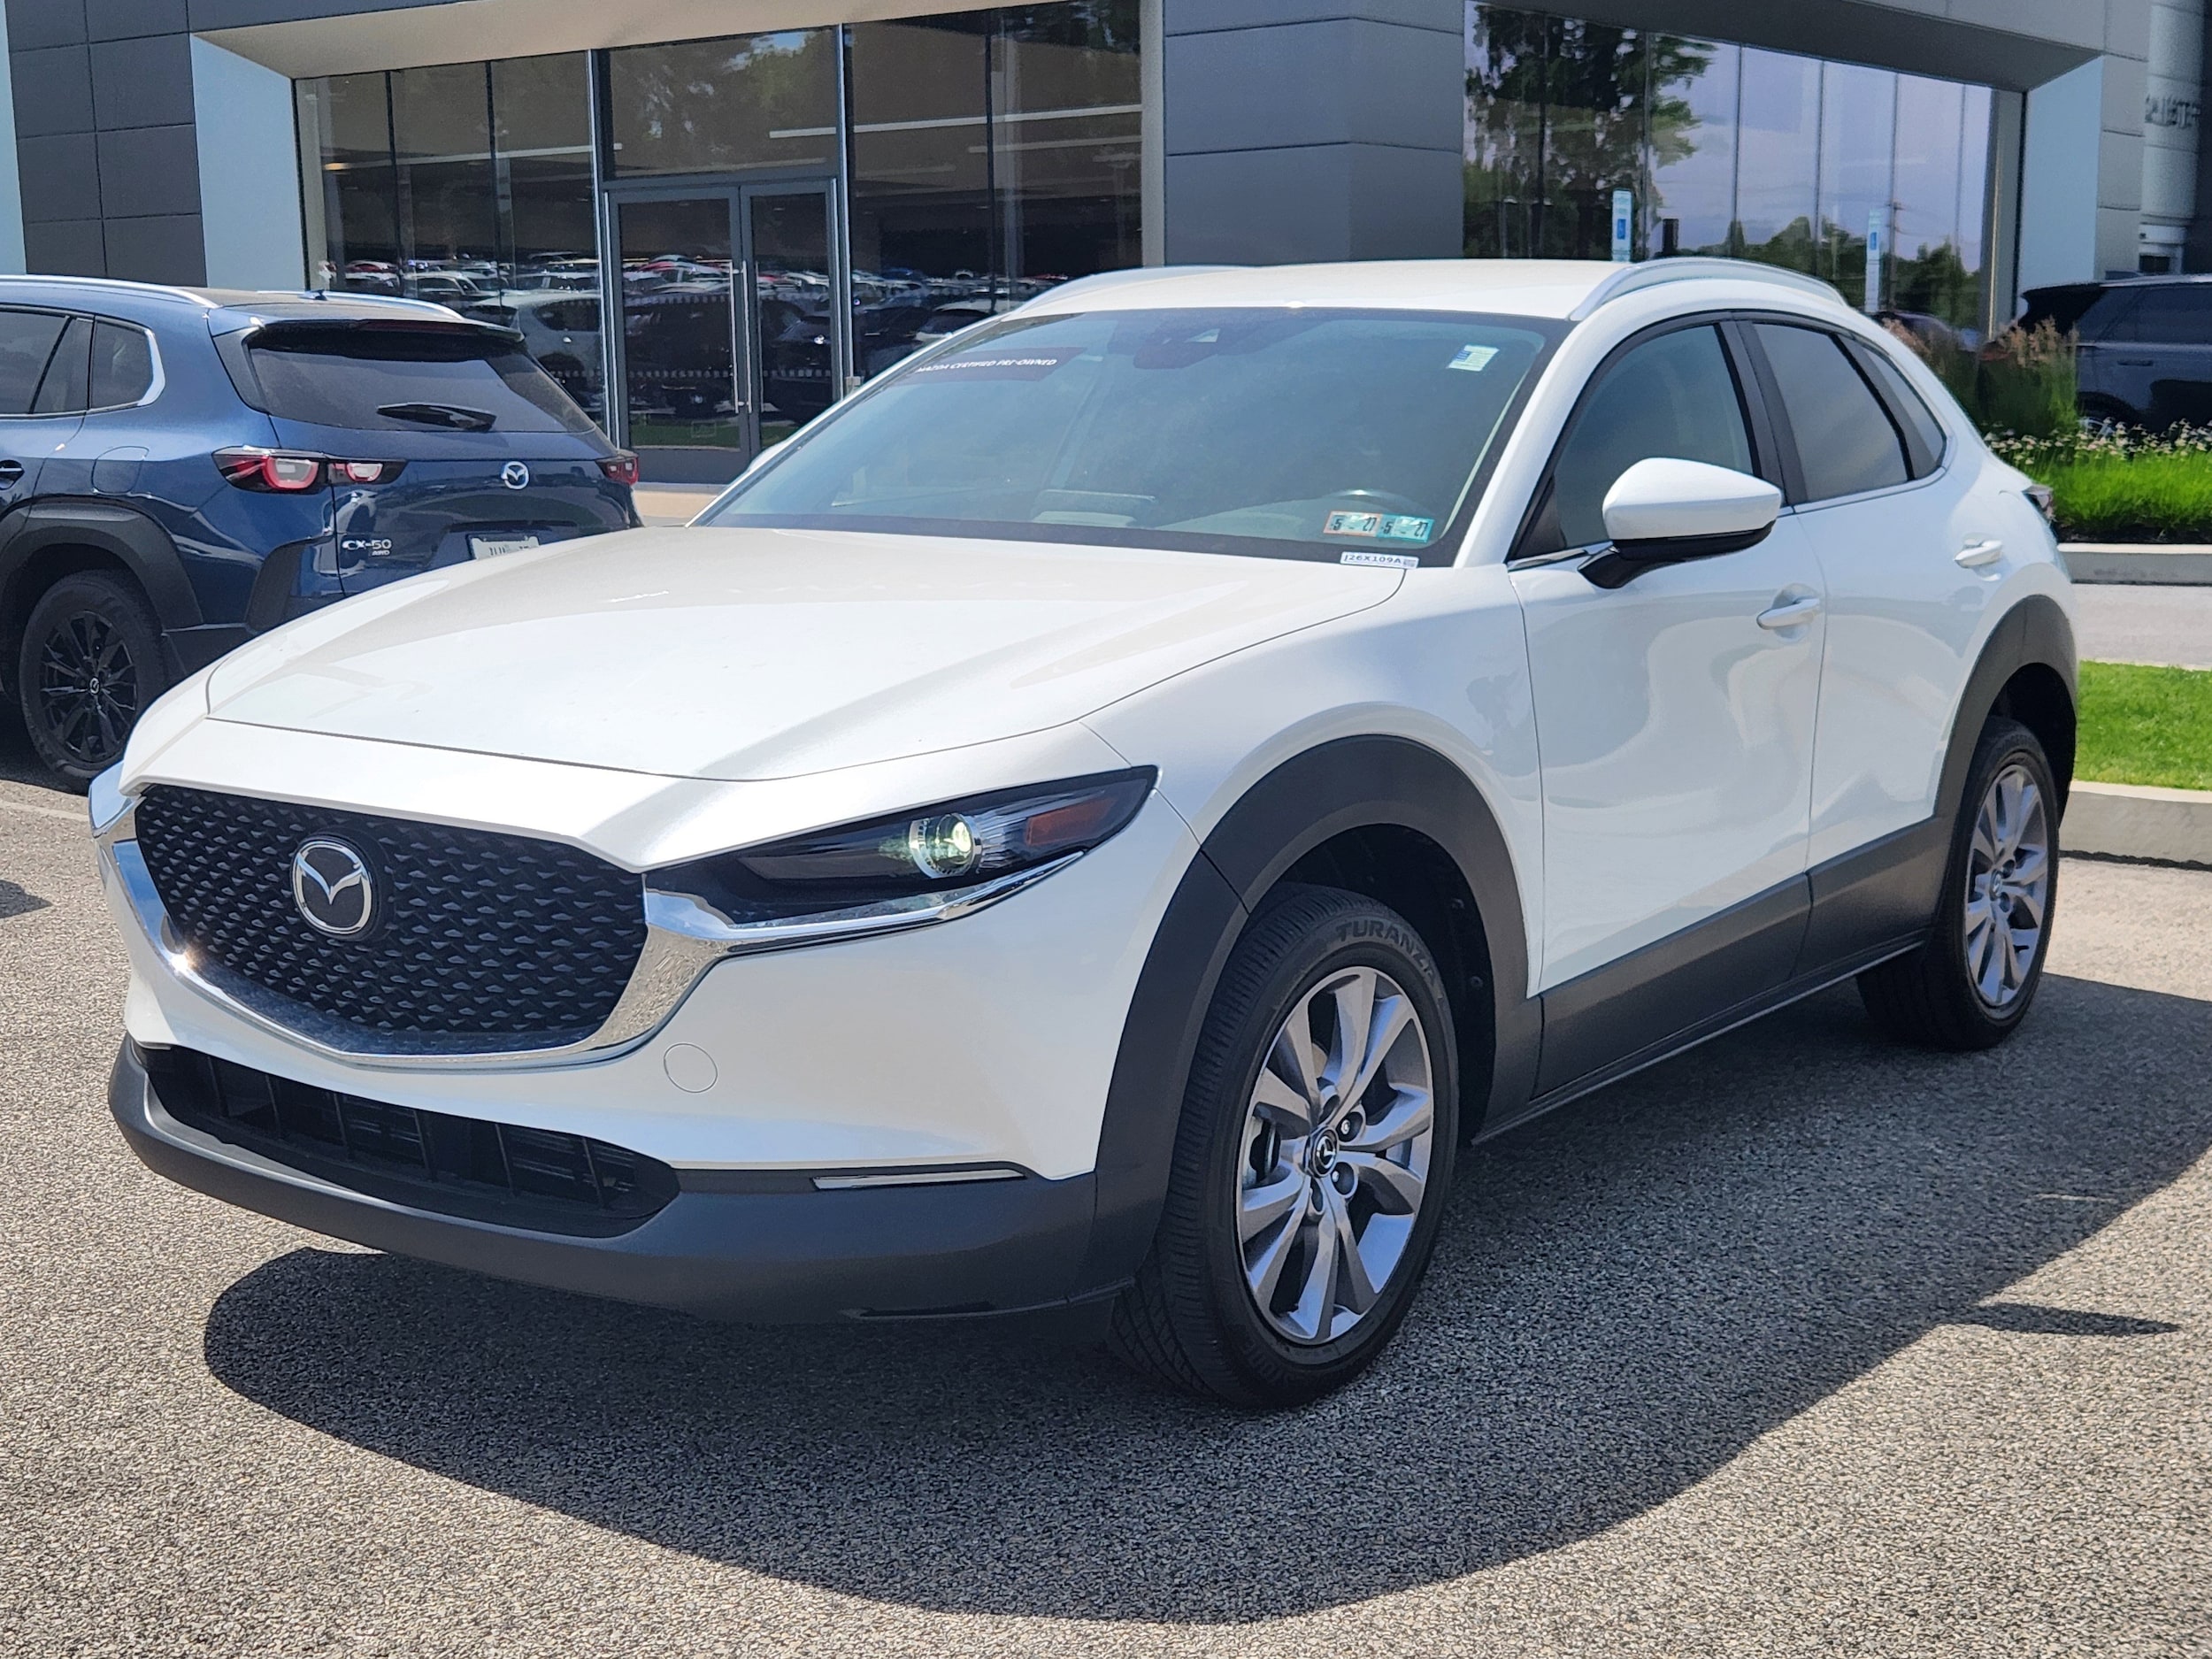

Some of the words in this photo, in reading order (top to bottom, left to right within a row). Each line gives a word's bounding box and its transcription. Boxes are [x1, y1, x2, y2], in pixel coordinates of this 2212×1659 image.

[950, 360, 996, 369] CERTIFIED
[995, 358, 1058, 367] PRE-OWNED
[342, 539, 392, 549] CX-50
[1344, 554, 1402, 564] J26X109A
